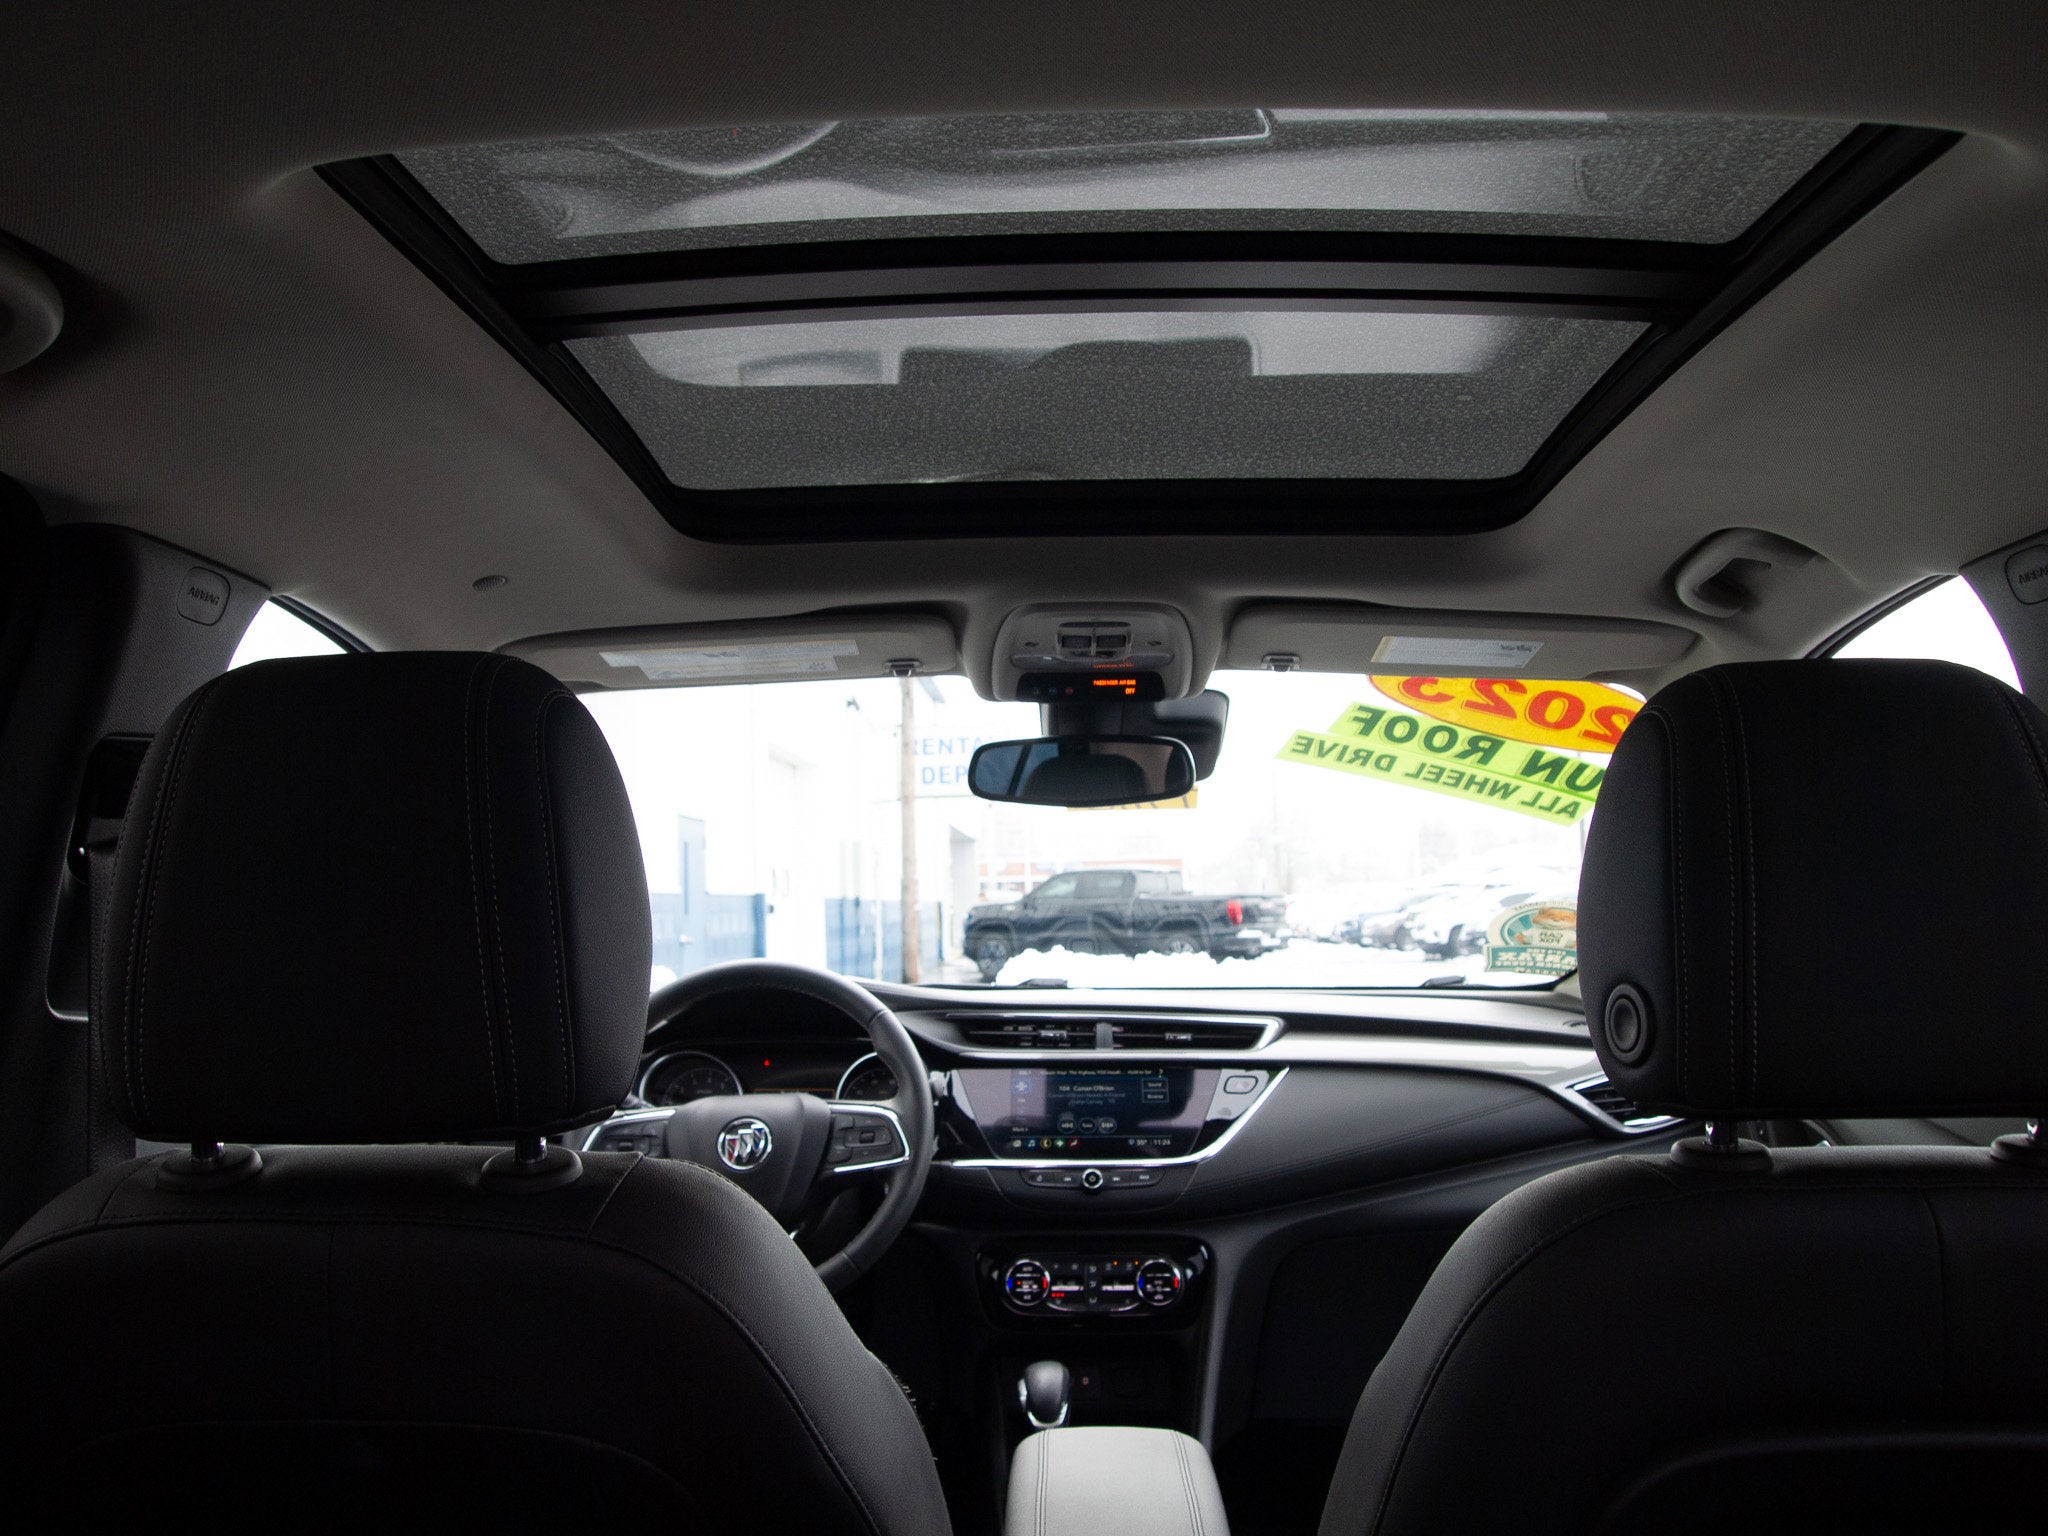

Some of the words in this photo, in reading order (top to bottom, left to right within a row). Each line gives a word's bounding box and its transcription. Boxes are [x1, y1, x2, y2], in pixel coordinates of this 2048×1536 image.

[1125, 687, 1136, 695] OFF
[913, 736, 986, 755] ENTA
[922, 765, 969, 785] DEP
